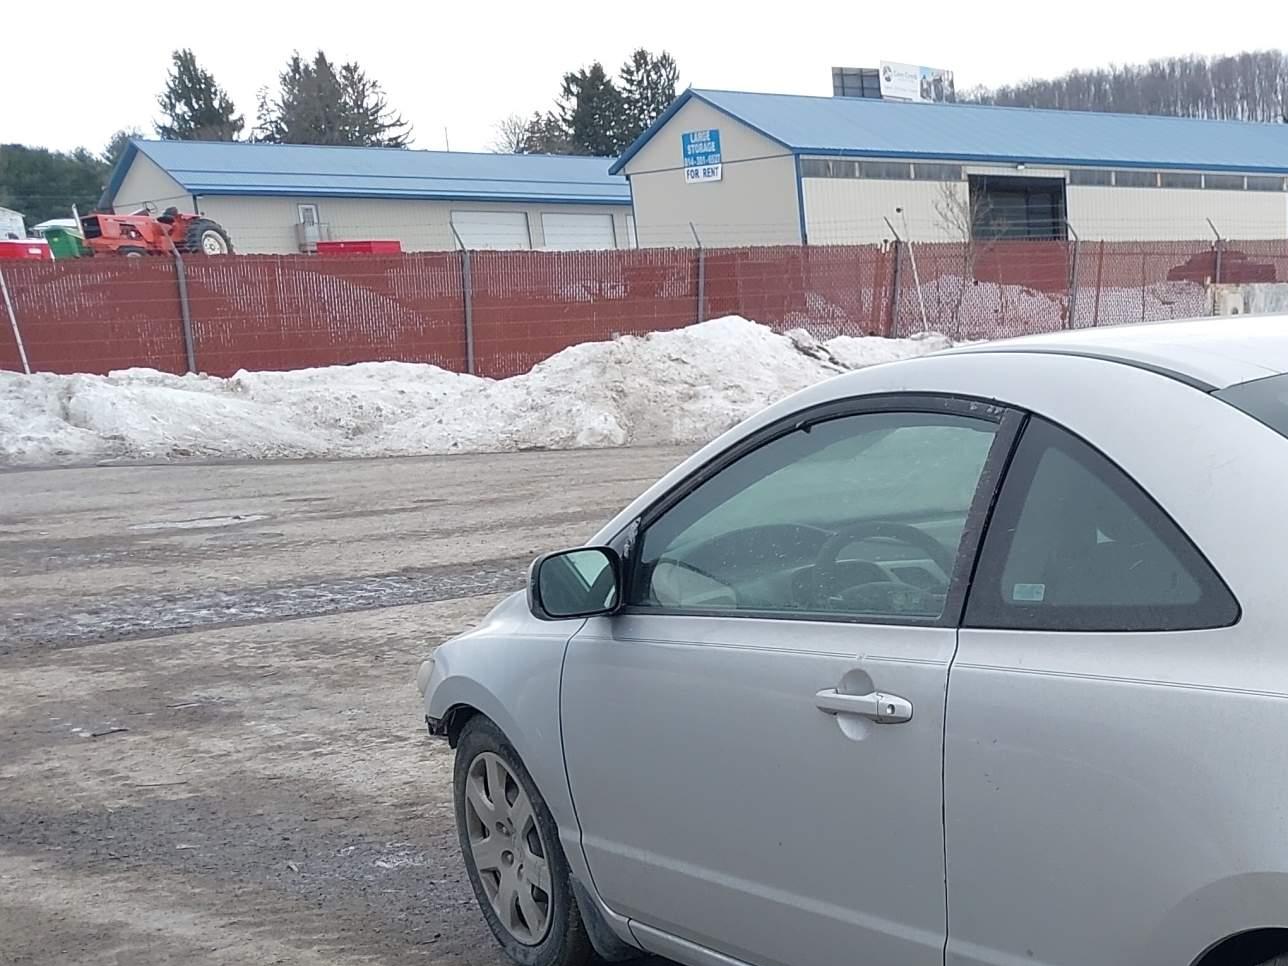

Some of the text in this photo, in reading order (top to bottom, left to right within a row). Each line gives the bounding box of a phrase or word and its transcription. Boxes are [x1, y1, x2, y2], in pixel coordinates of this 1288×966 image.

[687, 141, 716, 155] STORAGE
[687, 166, 719, 180] FOR RENT
